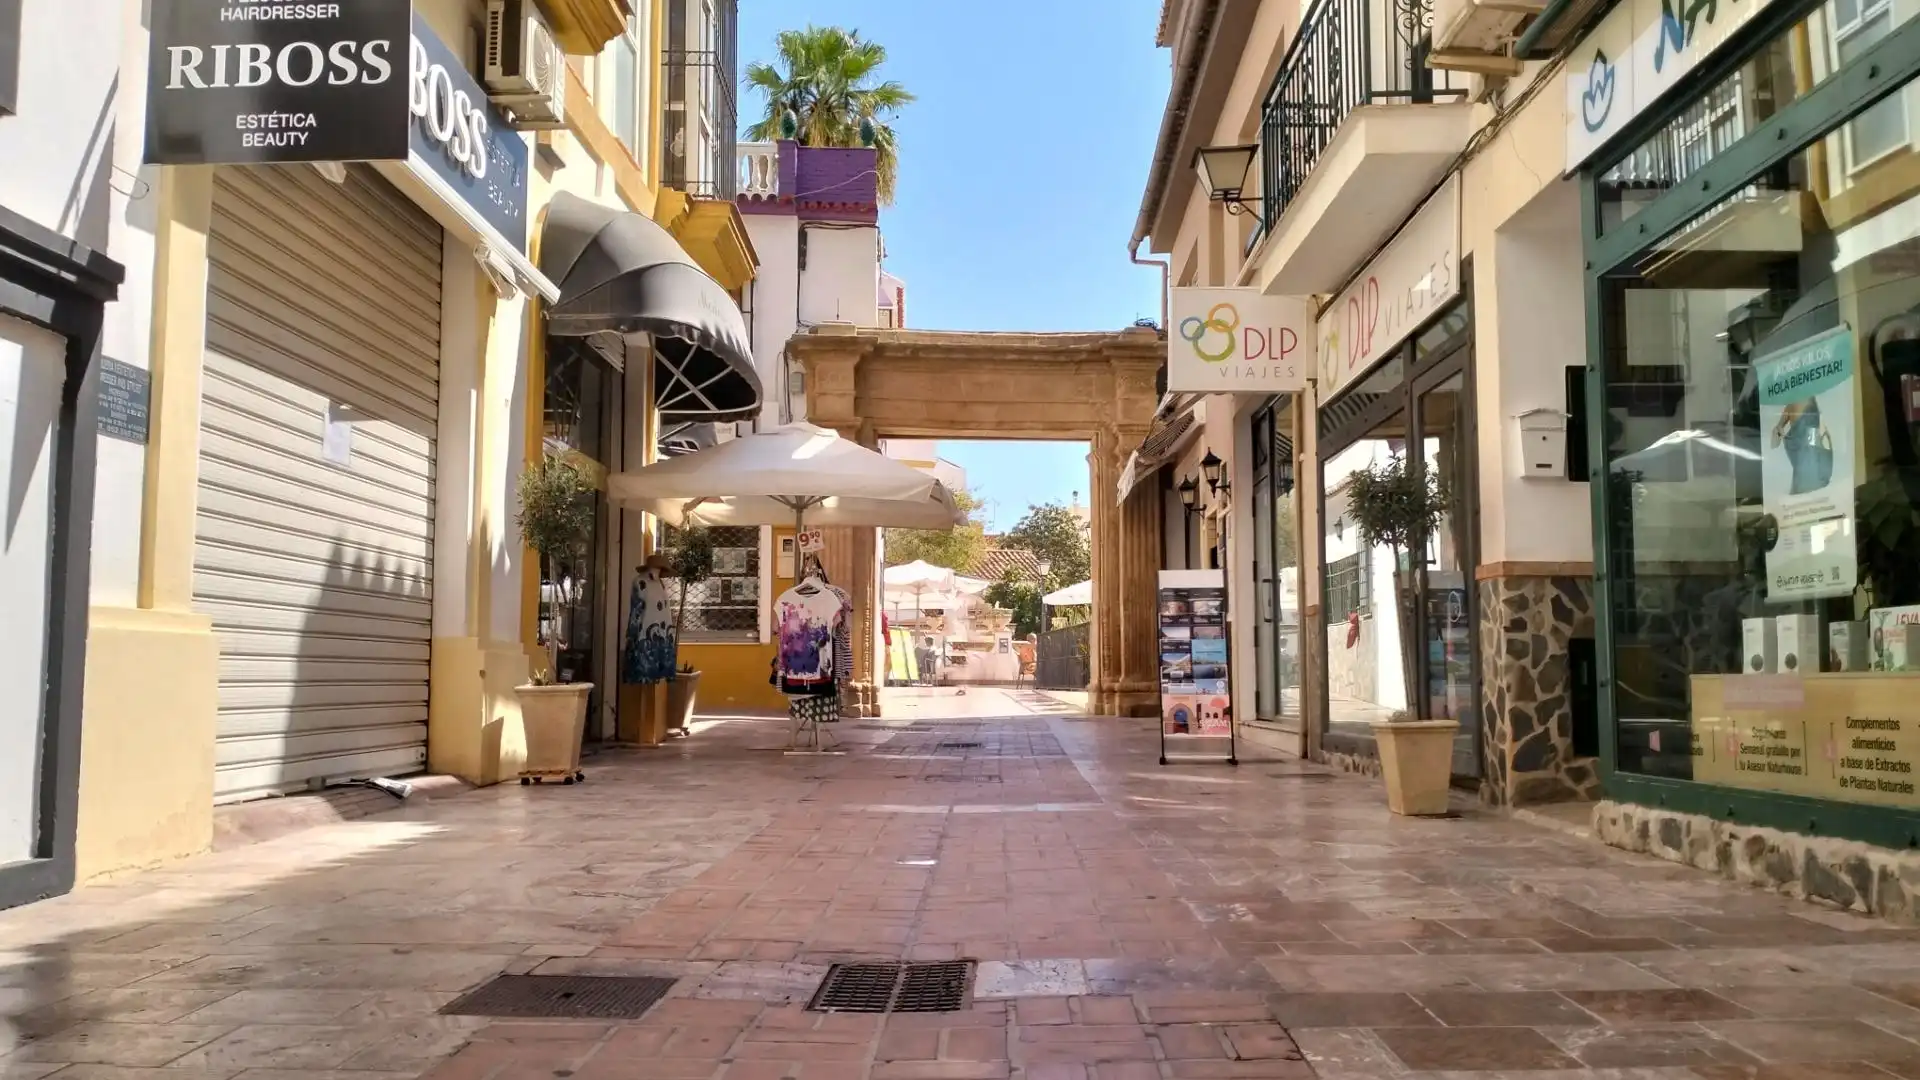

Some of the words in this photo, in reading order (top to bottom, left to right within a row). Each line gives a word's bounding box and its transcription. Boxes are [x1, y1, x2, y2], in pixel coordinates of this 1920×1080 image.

[220, 4, 340, 21] HAIRDRESSER
[165, 40, 392, 89] RIBOSS
[236, 111, 317, 129] ESTÉTICA
[242, 131, 309, 147] BEAUTY
[1347, 276, 1380, 370] DLP
[1384, 250, 1452, 336] VIAJES
[1244, 327, 1298, 361] DLP
[1220, 366, 1296, 379] VIAJES
[1768, 377, 1790, 397] HOLA
[1790, 359, 1844, 389] BIENESTAR!
[1846, 716, 1901, 732] Complementos
[1851, 735, 1897, 752] alimenticios
[1839, 757, 1845, 768] a
[1847, 756, 1863, 769] base
[1865, 757, 1874, 770] de
[1875, 758, 1911, 773] Extractos
[1839, 775, 1849, 788] de
[1850, 775, 1877, 791] Plantas
[1877, 777, 1915, 796] Naturales
